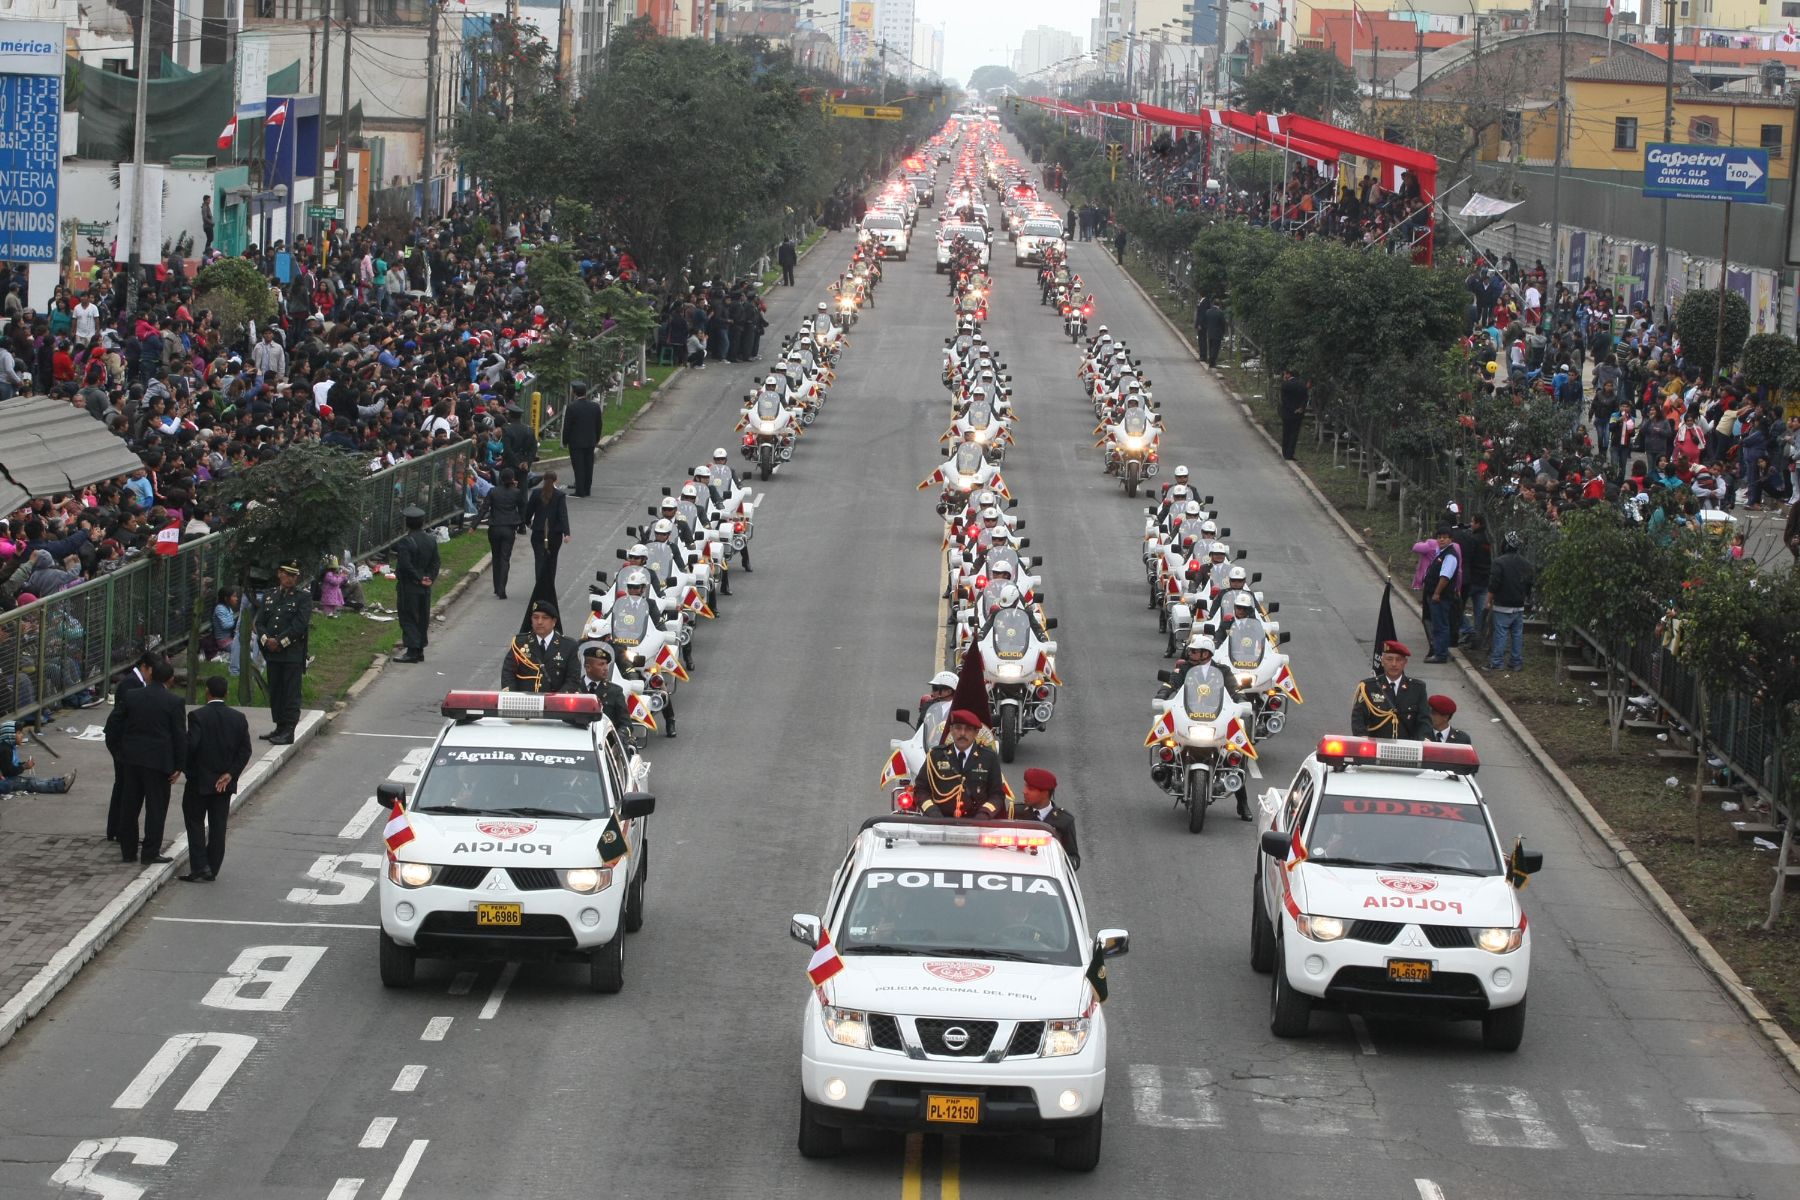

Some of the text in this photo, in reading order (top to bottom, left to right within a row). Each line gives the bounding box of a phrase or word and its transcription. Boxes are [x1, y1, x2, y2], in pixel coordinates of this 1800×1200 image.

[1, 38, 52, 54] mérica
[0, 170, 55, 189] NTERIA
[1661, 168, 1682, 176] GNV
[1688, 169, 1707, 177] GLP
[1730, 170, 1749, 178] 100
[1657, 176, 1710, 186] GASOLINAS
[0, 190, 47, 208] VADO
[0, 211, 55, 233] VENIDOS
[12, 244, 53, 258] HORAS
[1233, 660, 1259, 668] POLICIA
[1189, 711, 1216, 719] POLICIA
[1342, 799, 1466, 821] UDEX
[866, 872, 1058, 896] POLICIA
[480, 911, 518, 923] PL-6986
[1391, 968, 1428, 980] PL-6978
[922, 986, 980, 994] NACIONAL
[983, 989, 1003, 997] DEL
[1008, 992, 1038, 1001] PERU
[930, 1104, 975, 1120] PL-12150
